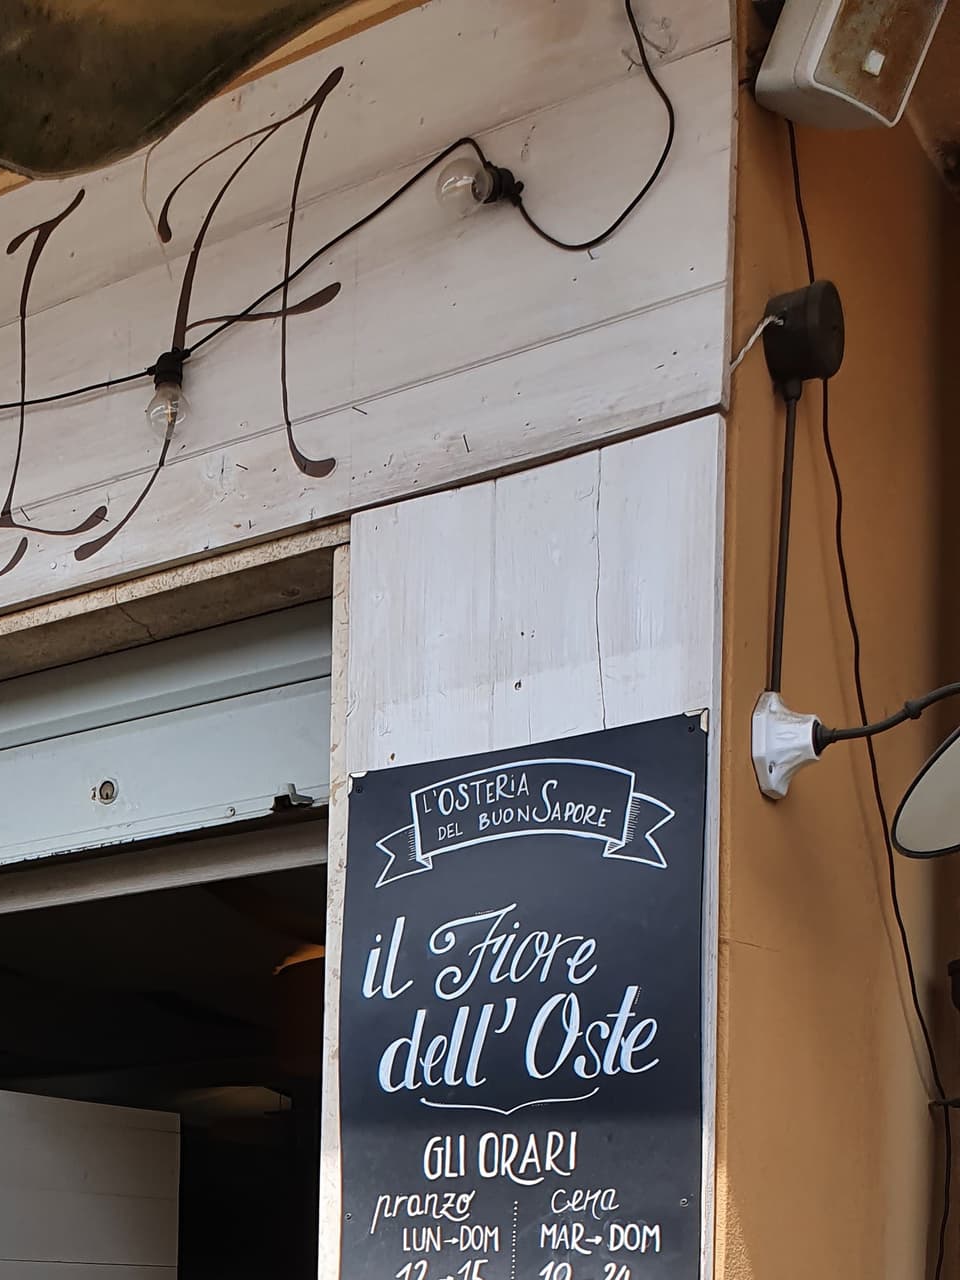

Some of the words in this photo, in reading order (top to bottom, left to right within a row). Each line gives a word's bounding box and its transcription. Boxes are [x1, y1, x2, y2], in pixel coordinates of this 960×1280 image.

[438, 824, 464, 842] DEL
[478, 803, 530, 831] BUON
[531, 779, 612, 829] SAPORE
[362, 915, 413, 1000] il
[429, 902, 598, 1001] Fiore
[378, 997, 518, 1093] dell'
[525, 984, 660, 1079] Oste
[423, 1132, 466, 1180] GLI
[478, 1131, 578, 1186] ORARI
[369, 1189, 475, 1235] pranzo
[551, 1187, 620, 1220] cena
[402, 1225, 441, 1252] LUN
[459, 1224, 500, 1253] DOM
[540, 1222, 593, 1255] MAR
[608, 1223, 661, 1254] DOM
